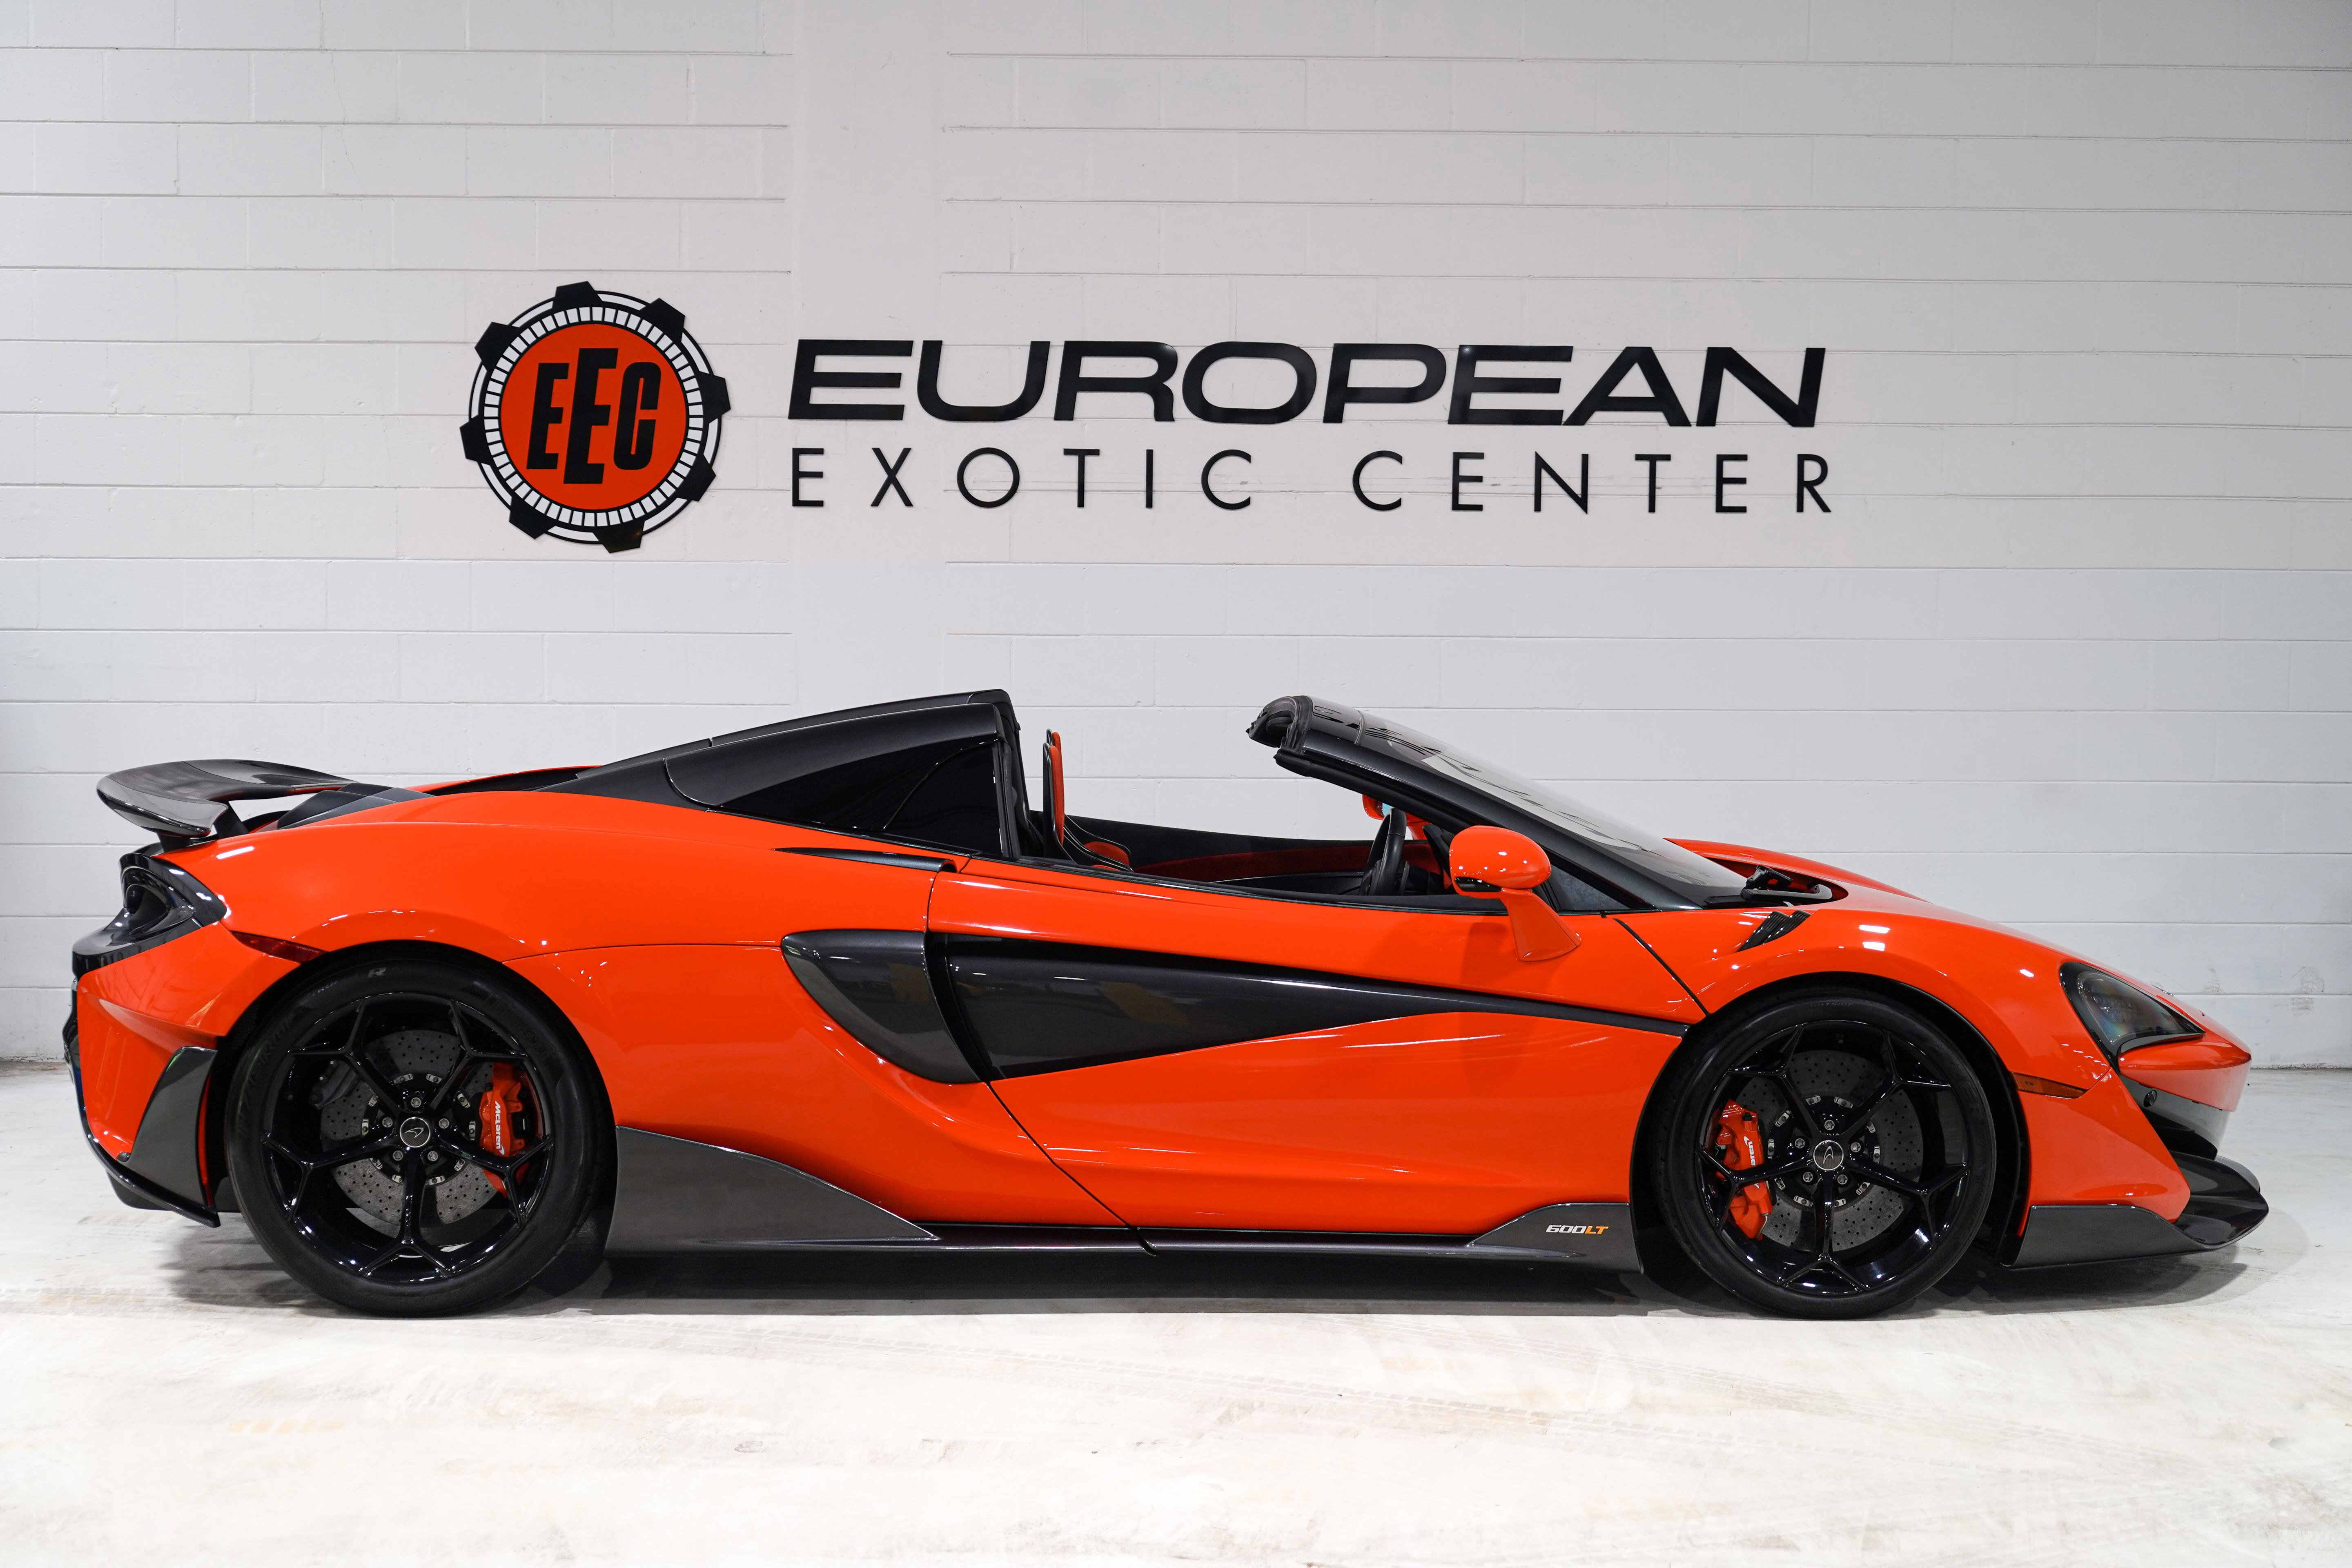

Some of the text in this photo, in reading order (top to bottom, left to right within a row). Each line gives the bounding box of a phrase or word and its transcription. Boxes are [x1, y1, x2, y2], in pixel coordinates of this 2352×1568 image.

[526, 348, 662, 484] EEC
[788, 339, 1826, 428] EUROPEAN
[792, 447, 1831, 514] EXOTIC CENTER
[1546, 1225, 1609, 1234] 600LT
